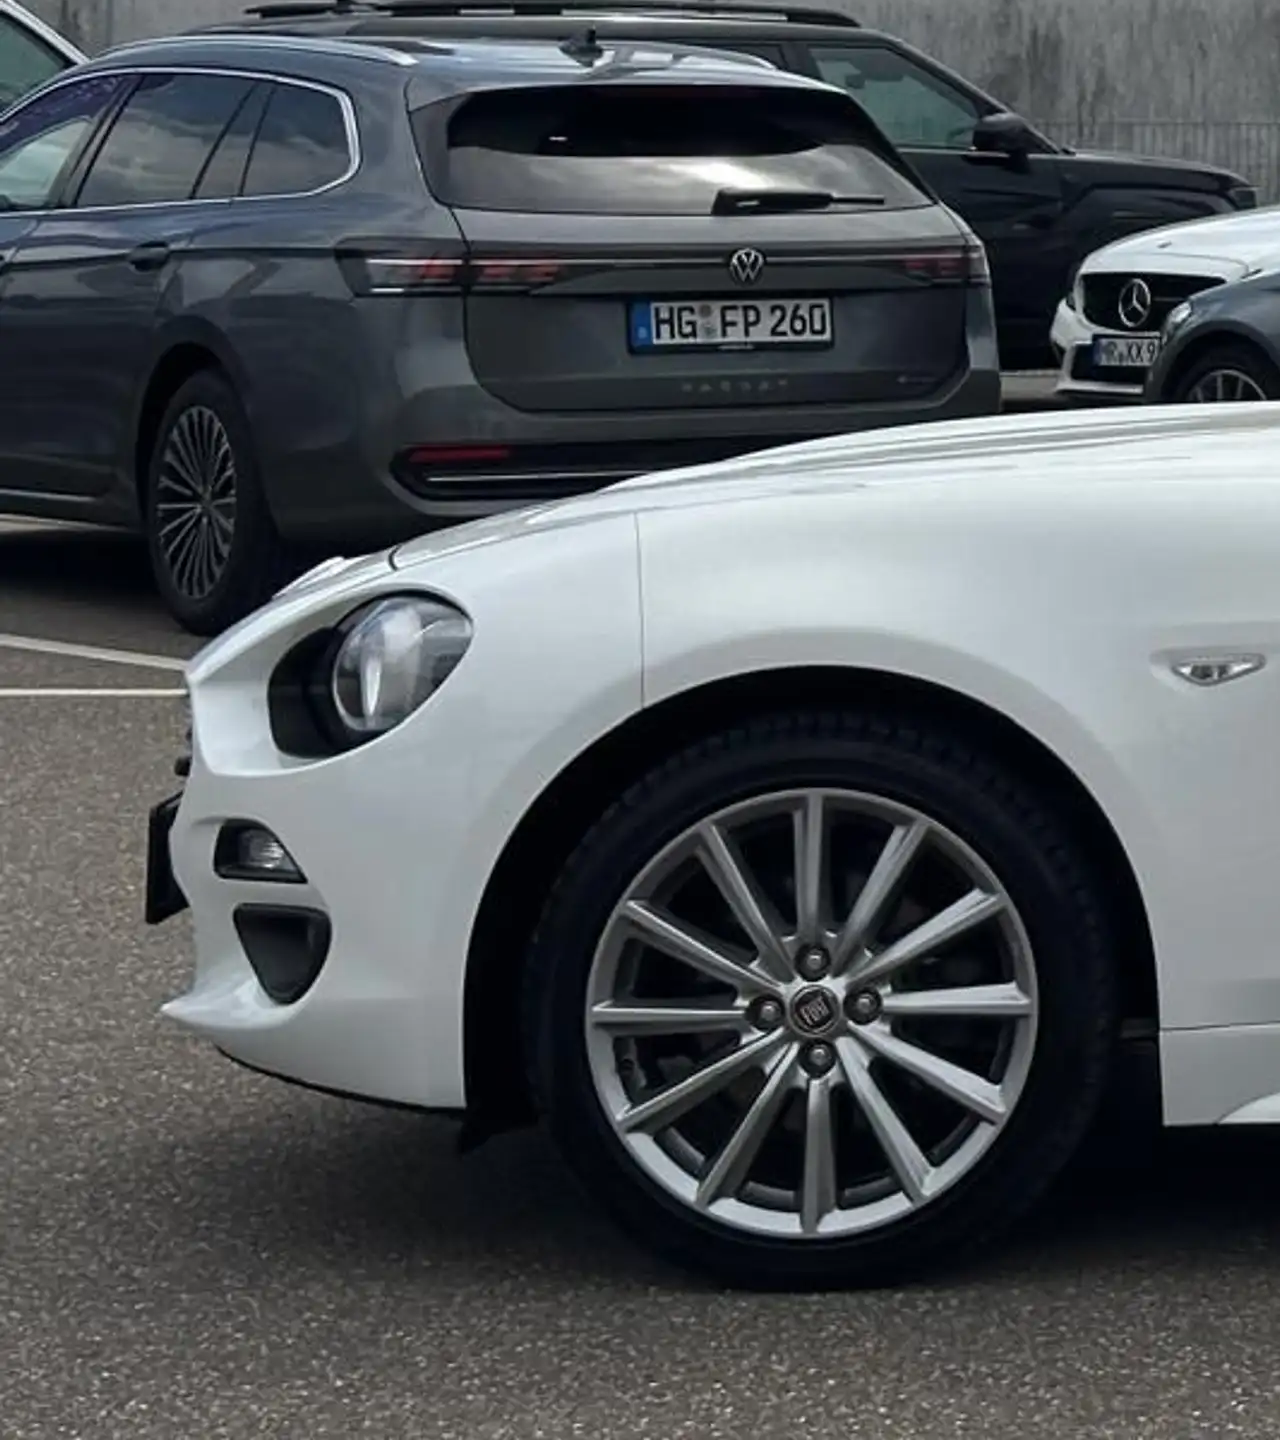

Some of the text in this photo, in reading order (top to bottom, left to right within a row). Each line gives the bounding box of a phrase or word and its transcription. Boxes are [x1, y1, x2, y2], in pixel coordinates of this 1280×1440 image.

[654, 303, 827, 340] HG FP 260
